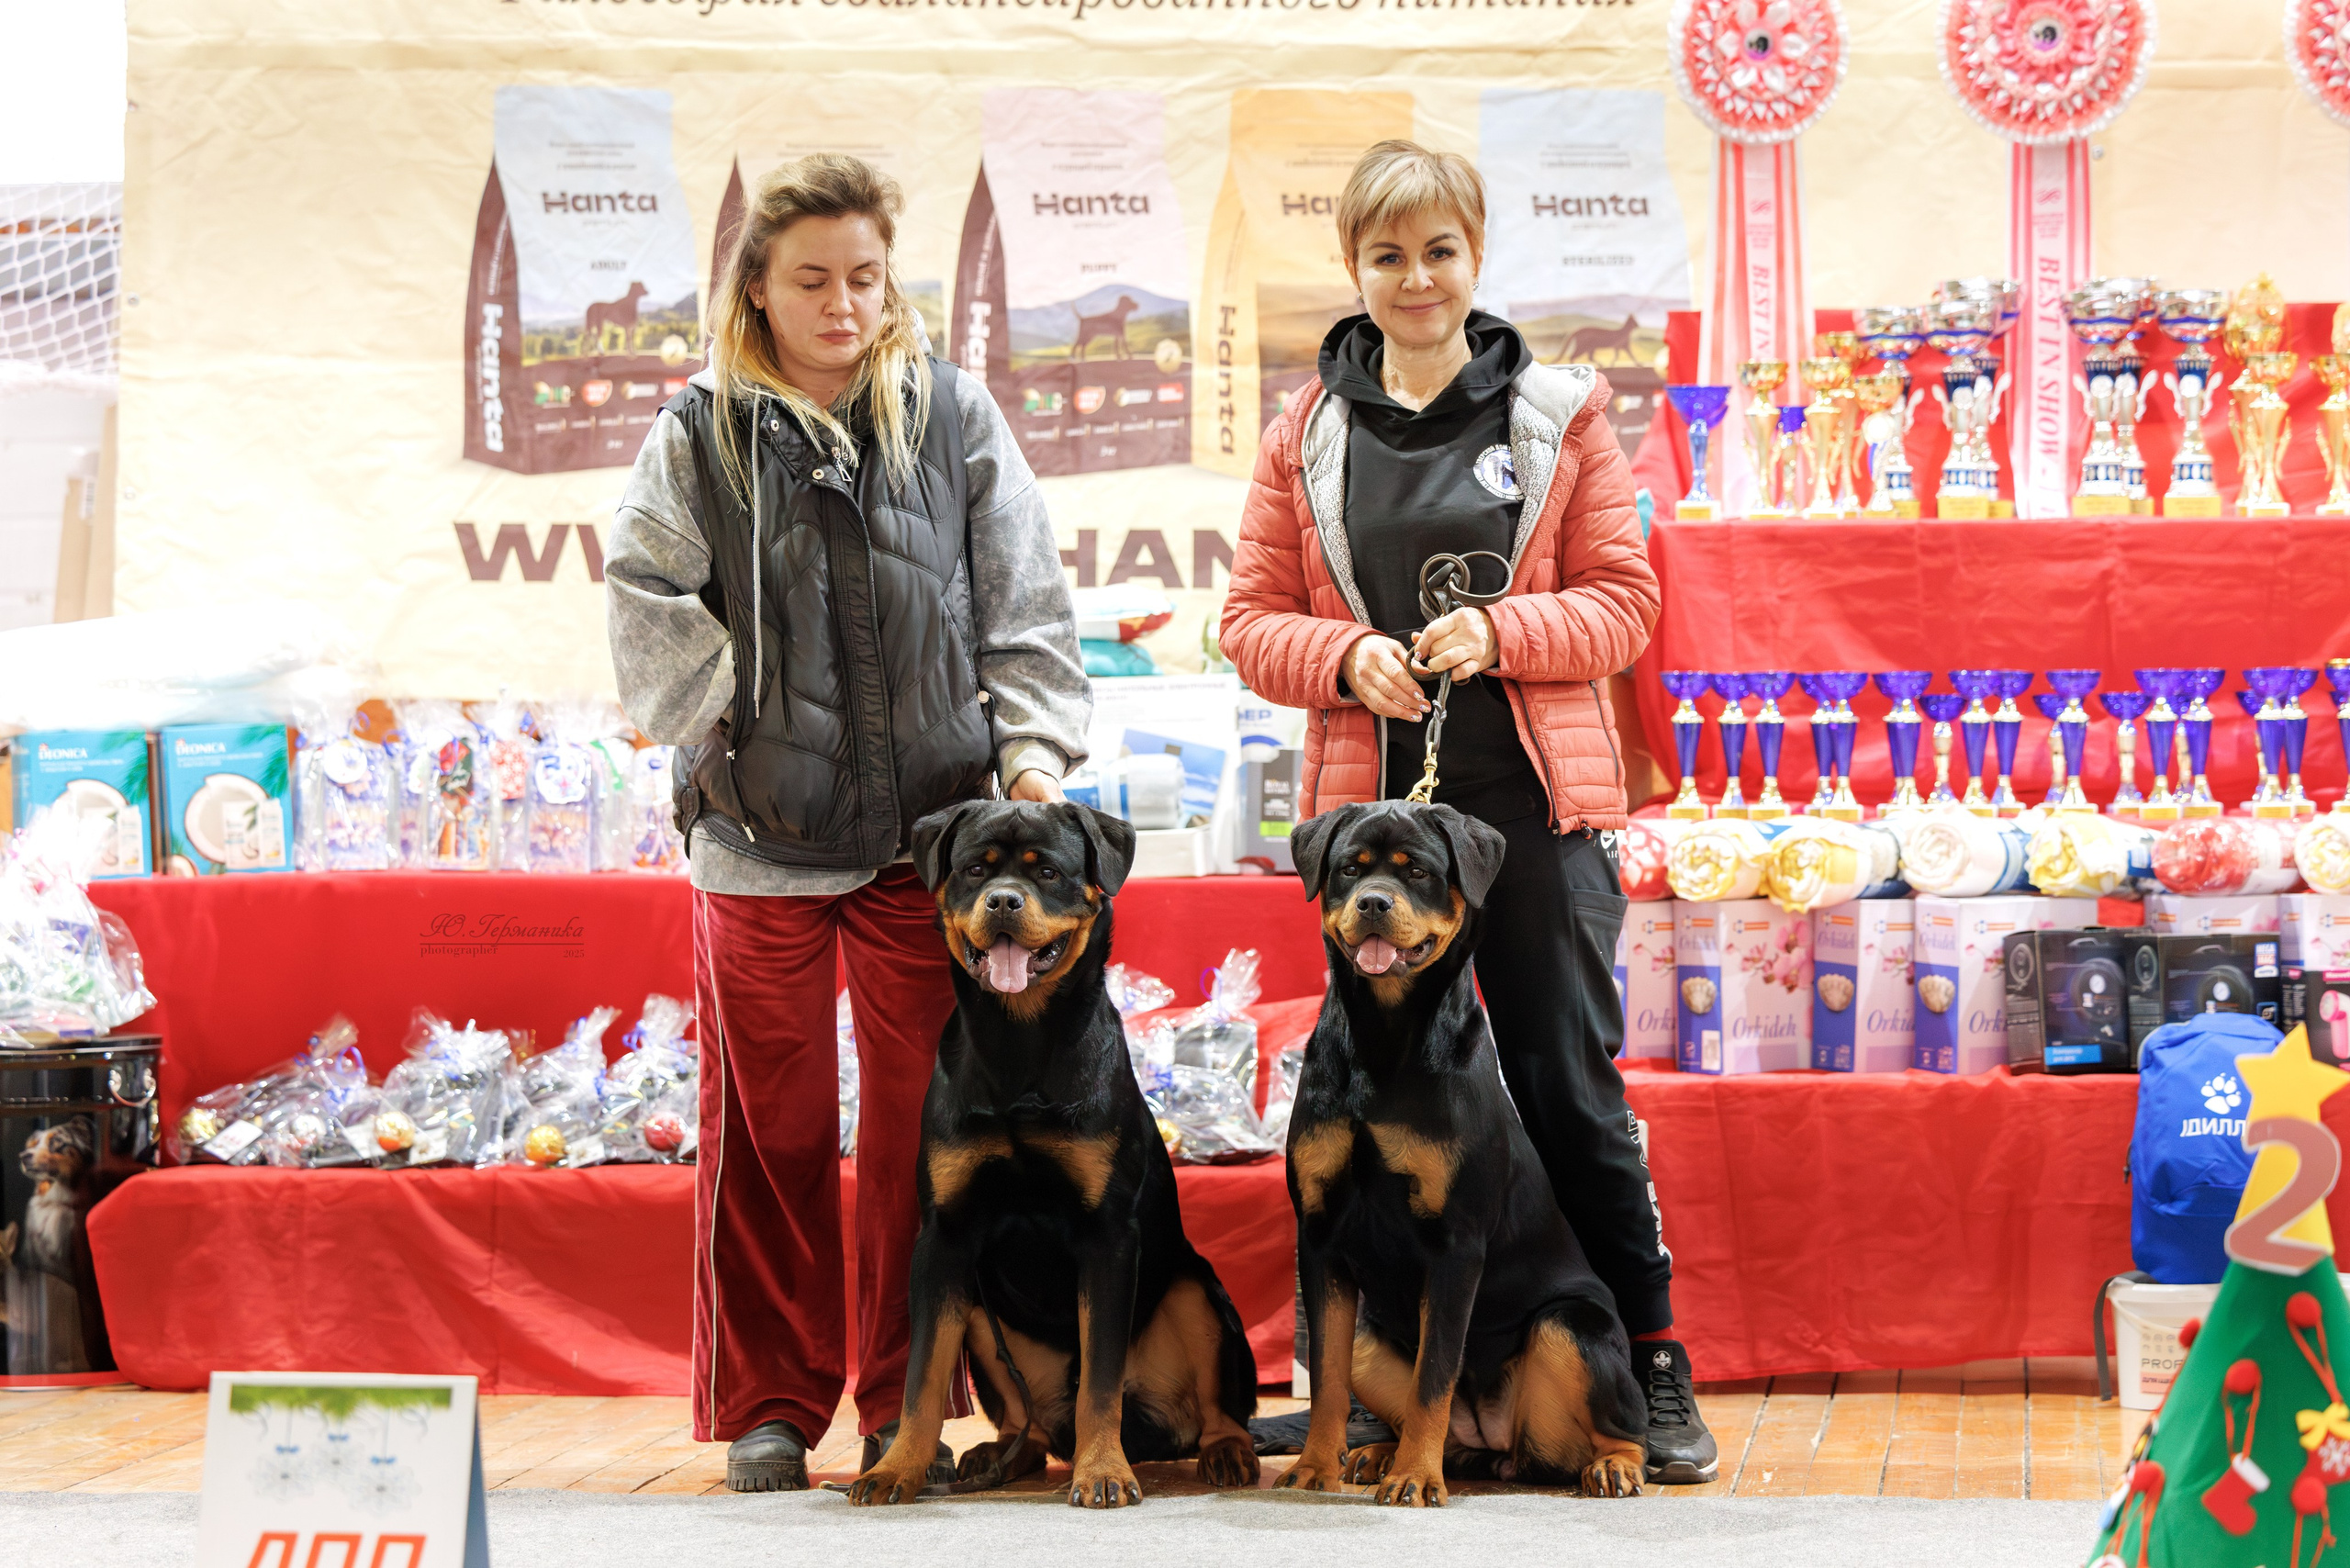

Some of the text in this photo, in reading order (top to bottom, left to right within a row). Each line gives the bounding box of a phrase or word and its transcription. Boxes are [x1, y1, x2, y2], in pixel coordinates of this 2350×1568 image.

[543, 190, 658, 214] Hanta
[1033, 193, 1150, 216] Hanta
[1281, 194, 1341, 216] Ha
[1532, 193, 1649, 217] Hanta
[2038, 256, 2061, 330] BEST
[2038, 336, 2061, 371] IN
[482, 302, 505, 453] Hanta
[1217, 304, 1237, 455] Hanta
[1732, 1014, 1796, 1039] Orkideh
